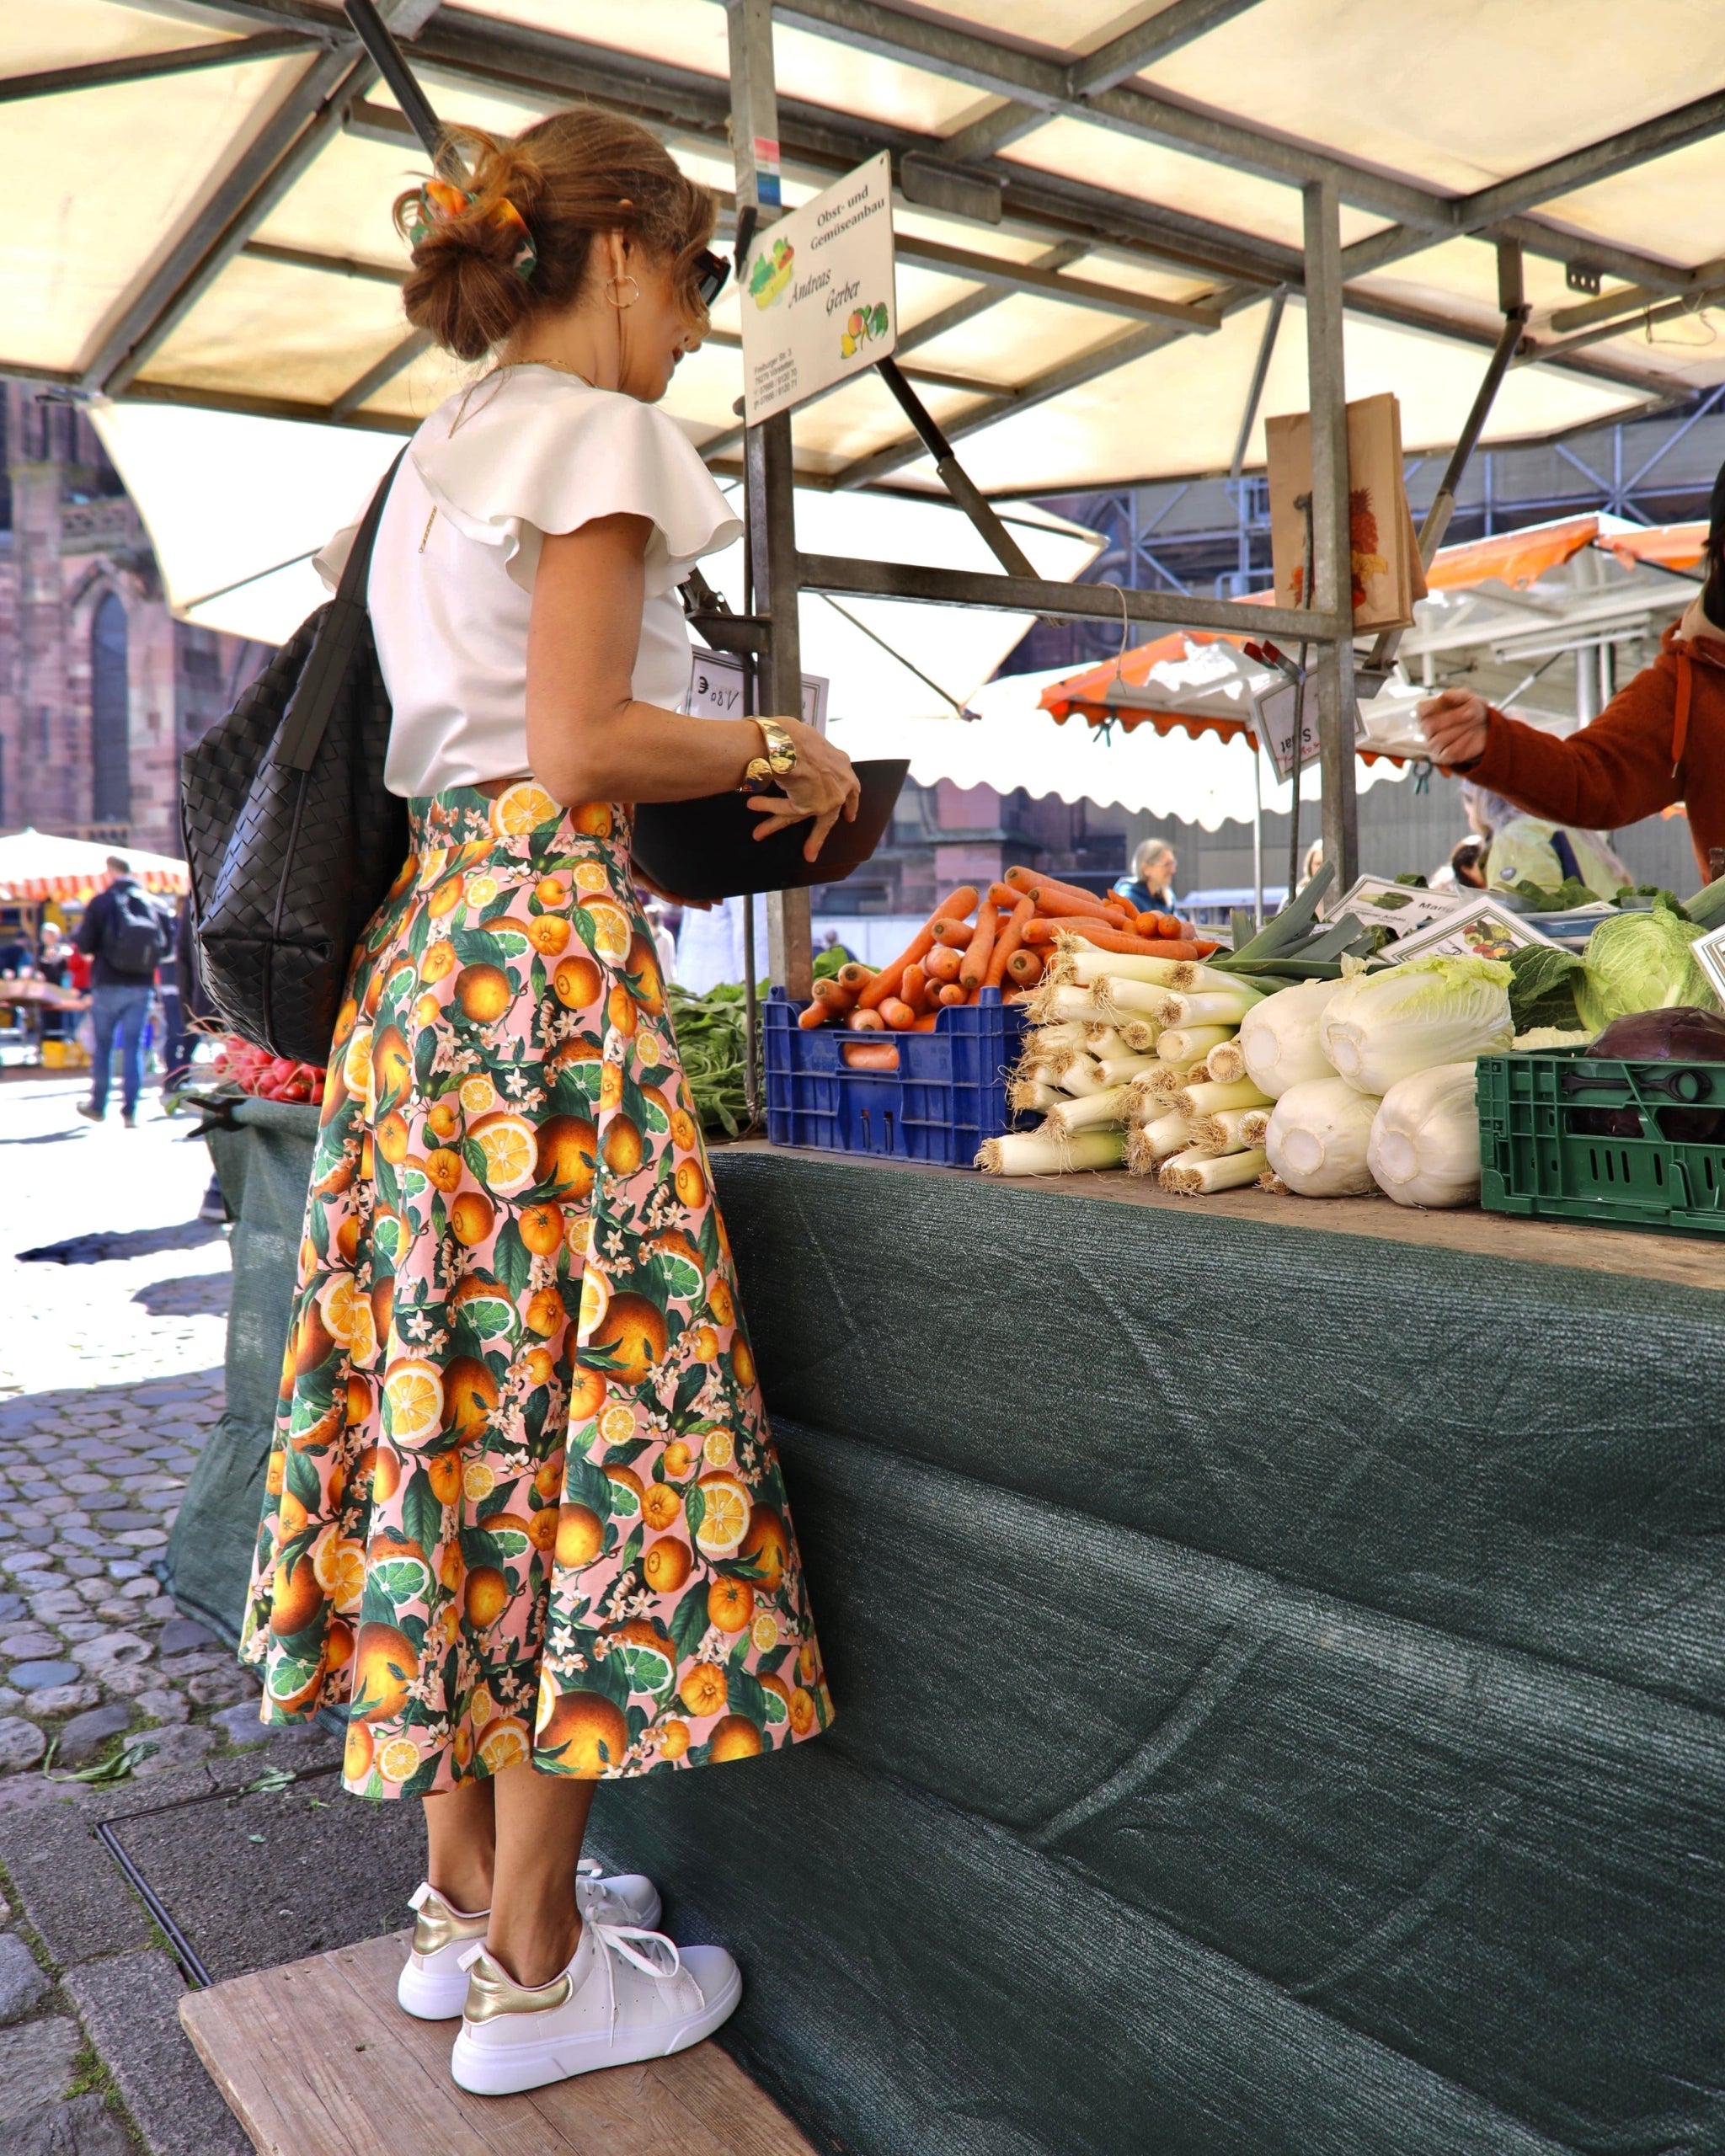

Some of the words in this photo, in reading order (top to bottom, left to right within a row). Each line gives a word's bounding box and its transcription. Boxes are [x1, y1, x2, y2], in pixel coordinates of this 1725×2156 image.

[810, 198, 884, 250] Gemüseanbau
[817, 205, 845, 227] Obst-
[847, 184, 868, 208] und
[788, 269, 831, 309] Andreas
[826, 280, 860, 317] Gerber
[1280, 728, 1311, 754] Sat
